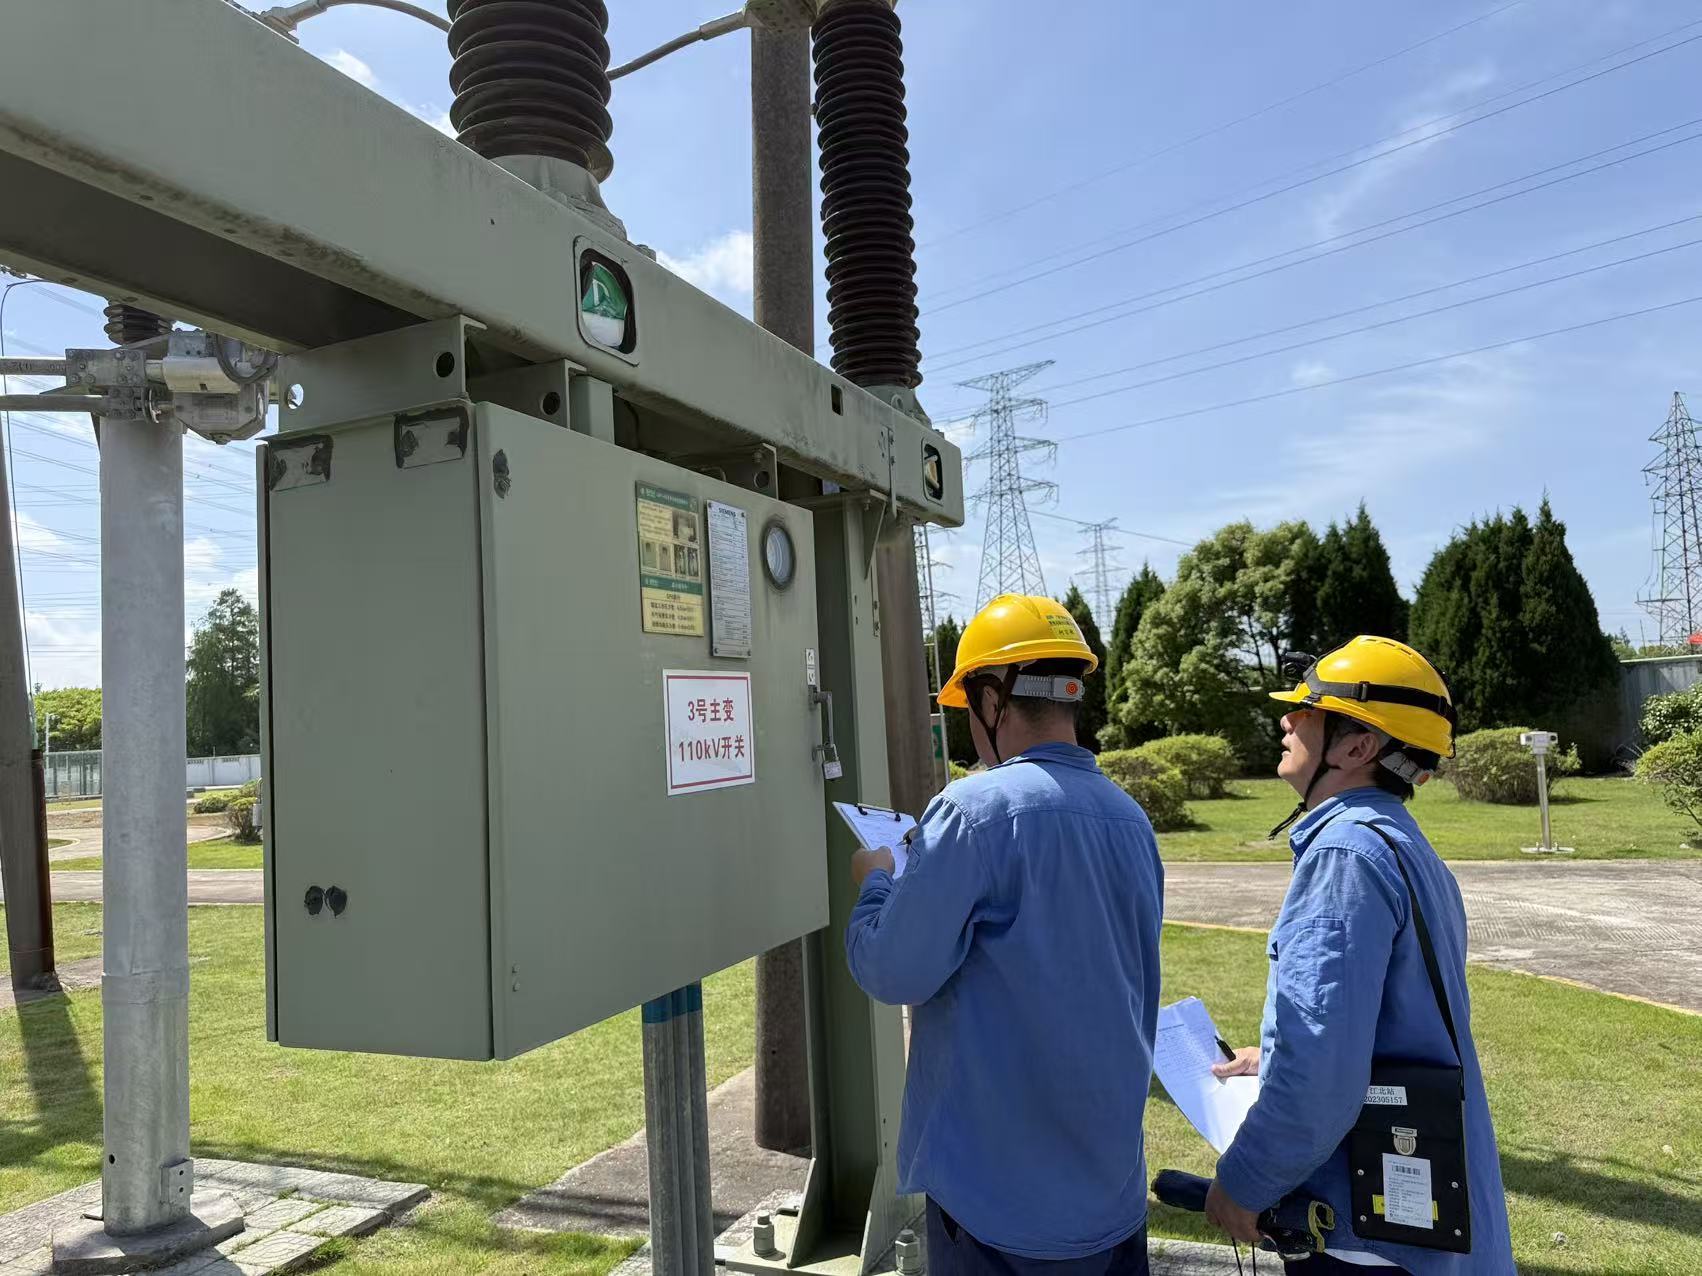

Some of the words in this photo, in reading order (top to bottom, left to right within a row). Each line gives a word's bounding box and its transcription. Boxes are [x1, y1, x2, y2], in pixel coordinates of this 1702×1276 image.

[719, 508, 736, 517] SIEMENS
[687, 698, 734, 723] 3号主变
[679, 735, 745, 762] 110kV开关
[1363, 1095, 1403, 1104] 202305157
